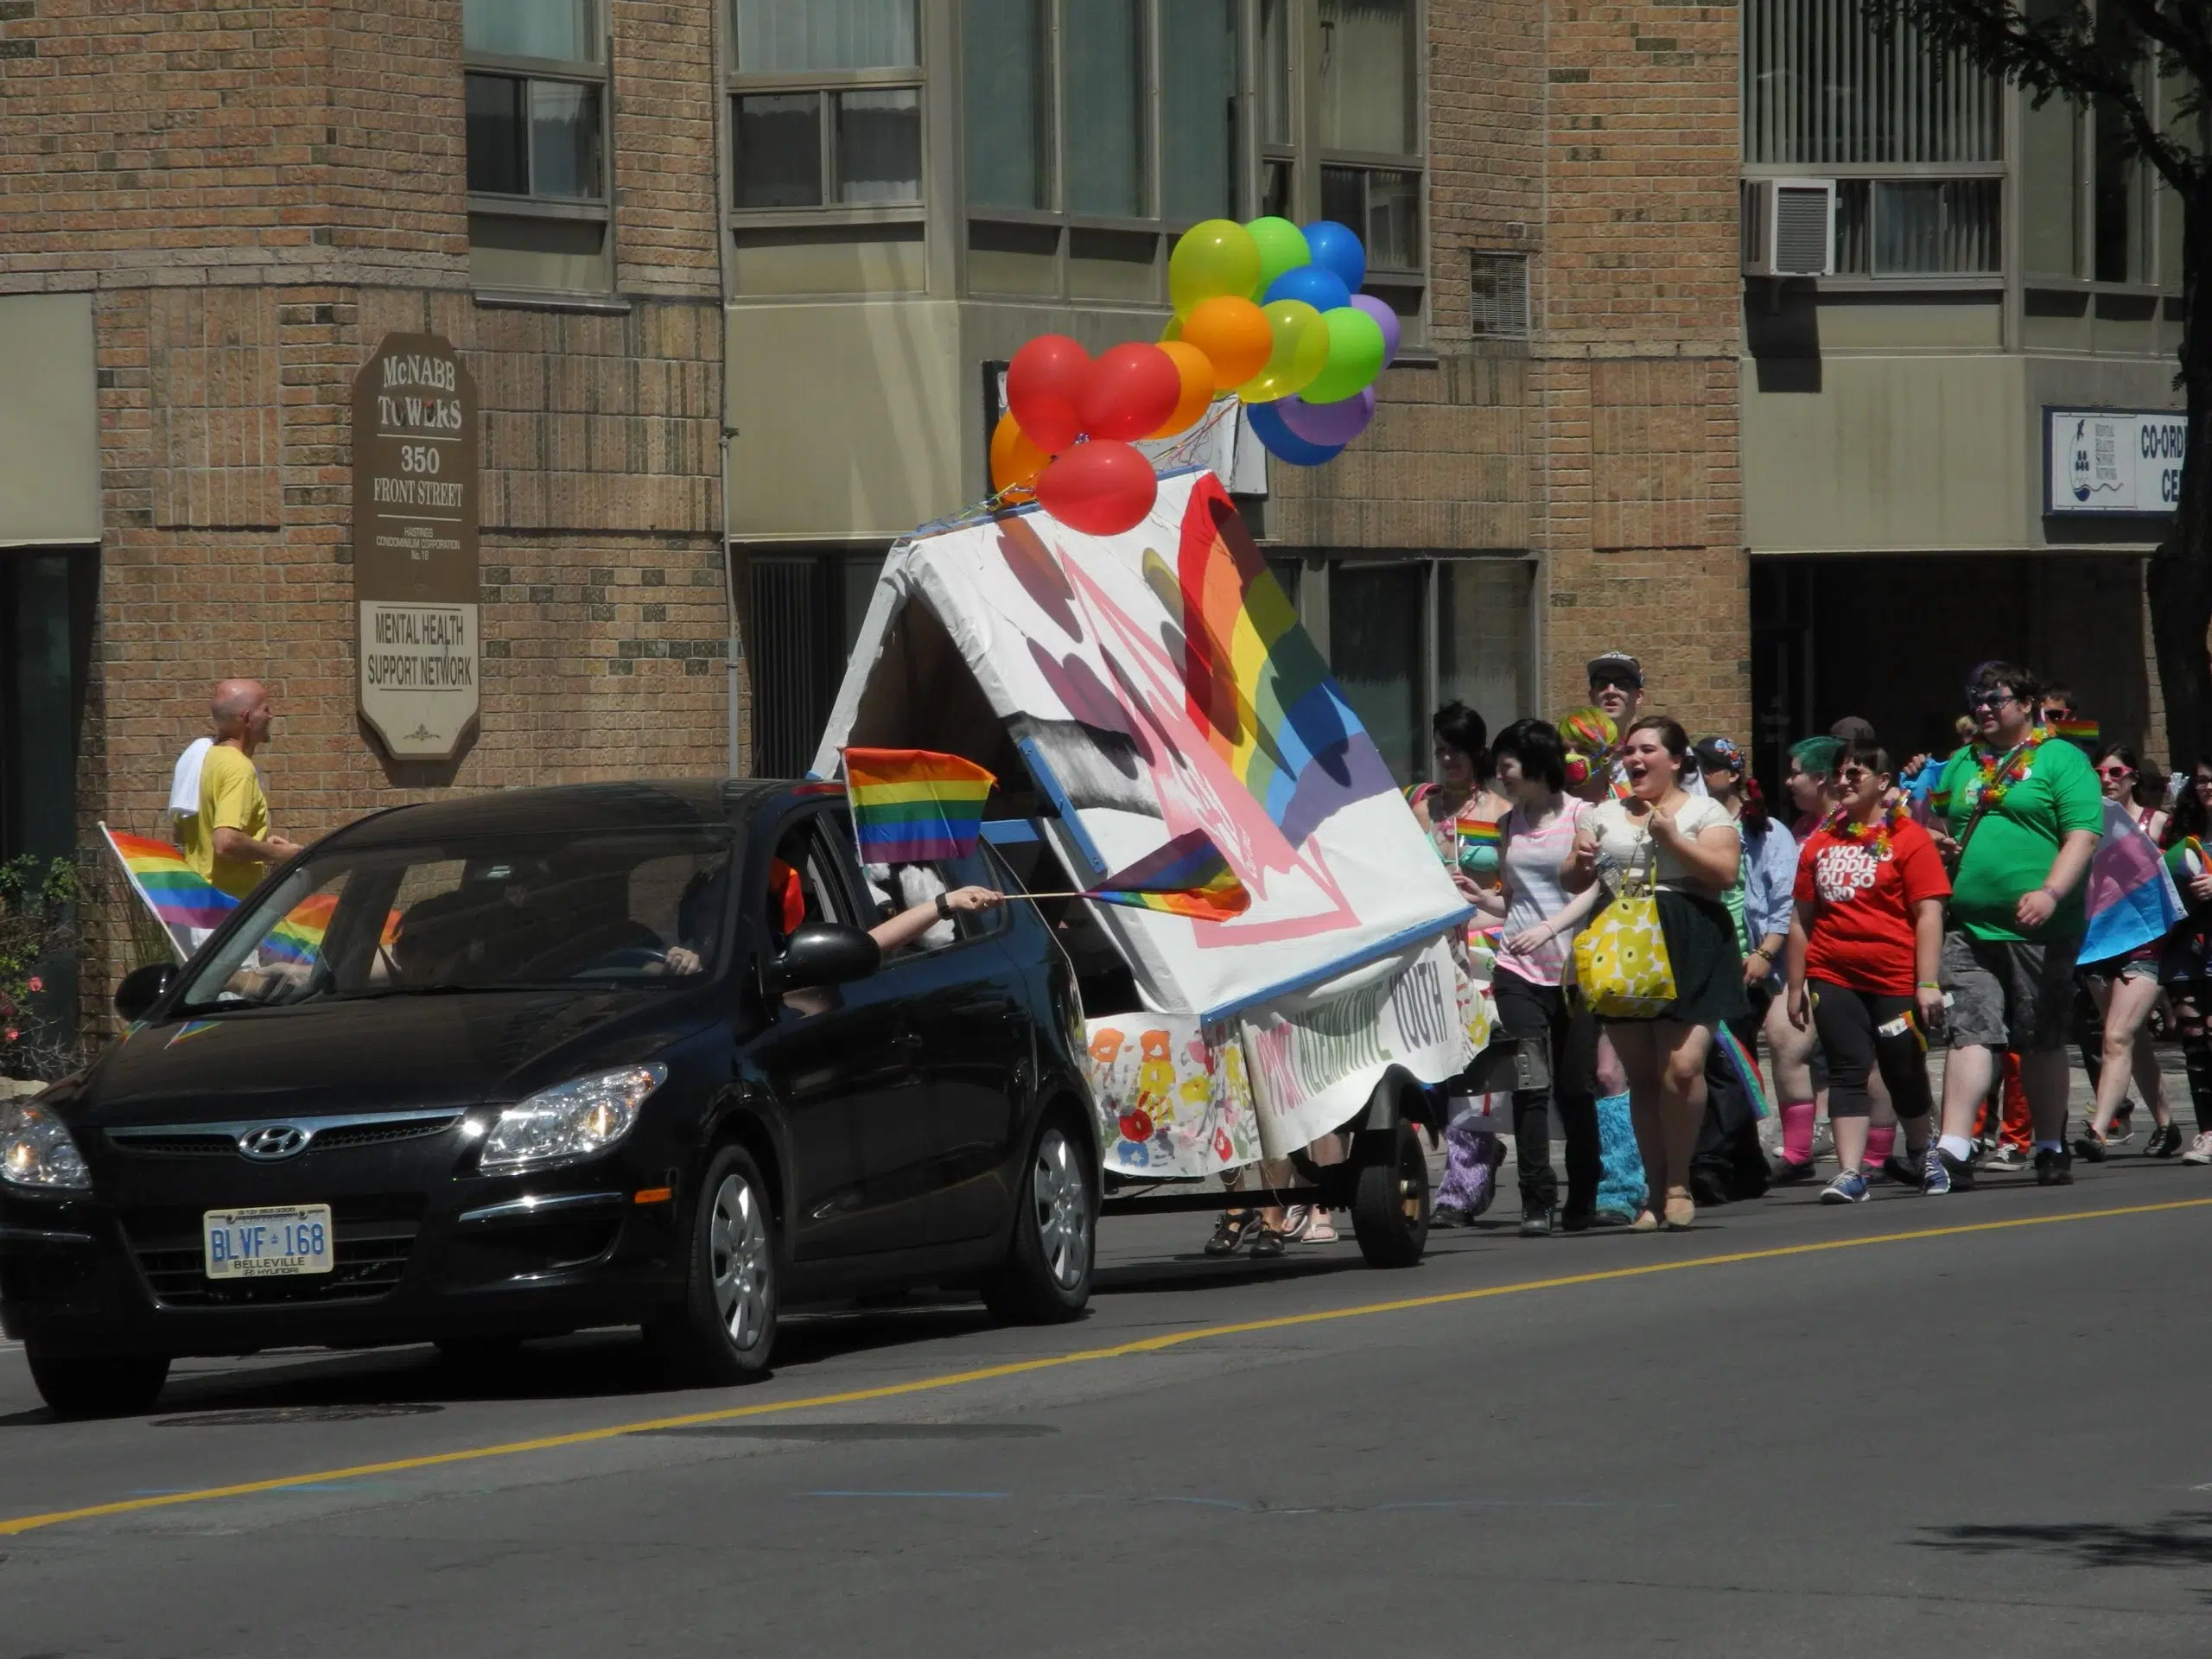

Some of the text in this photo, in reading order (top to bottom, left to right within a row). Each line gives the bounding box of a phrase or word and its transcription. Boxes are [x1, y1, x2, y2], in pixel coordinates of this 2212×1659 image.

[383, 354, 455, 391] McNABB
[401, 445, 440, 474] 350
[373, 477, 464, 507] FRONT STREET
[375, 613, 464, 645] MENTAL HEALTH
[367, 654, 472, 686] SUPPORT NETWORK
[1849, 872, 1876, 889] SO
[1389, 960, 1448, 1053] YOUTH
[284, 1222, 325, 1256] 168
[233, 1257, 305, 1269] BELLEVILLE
